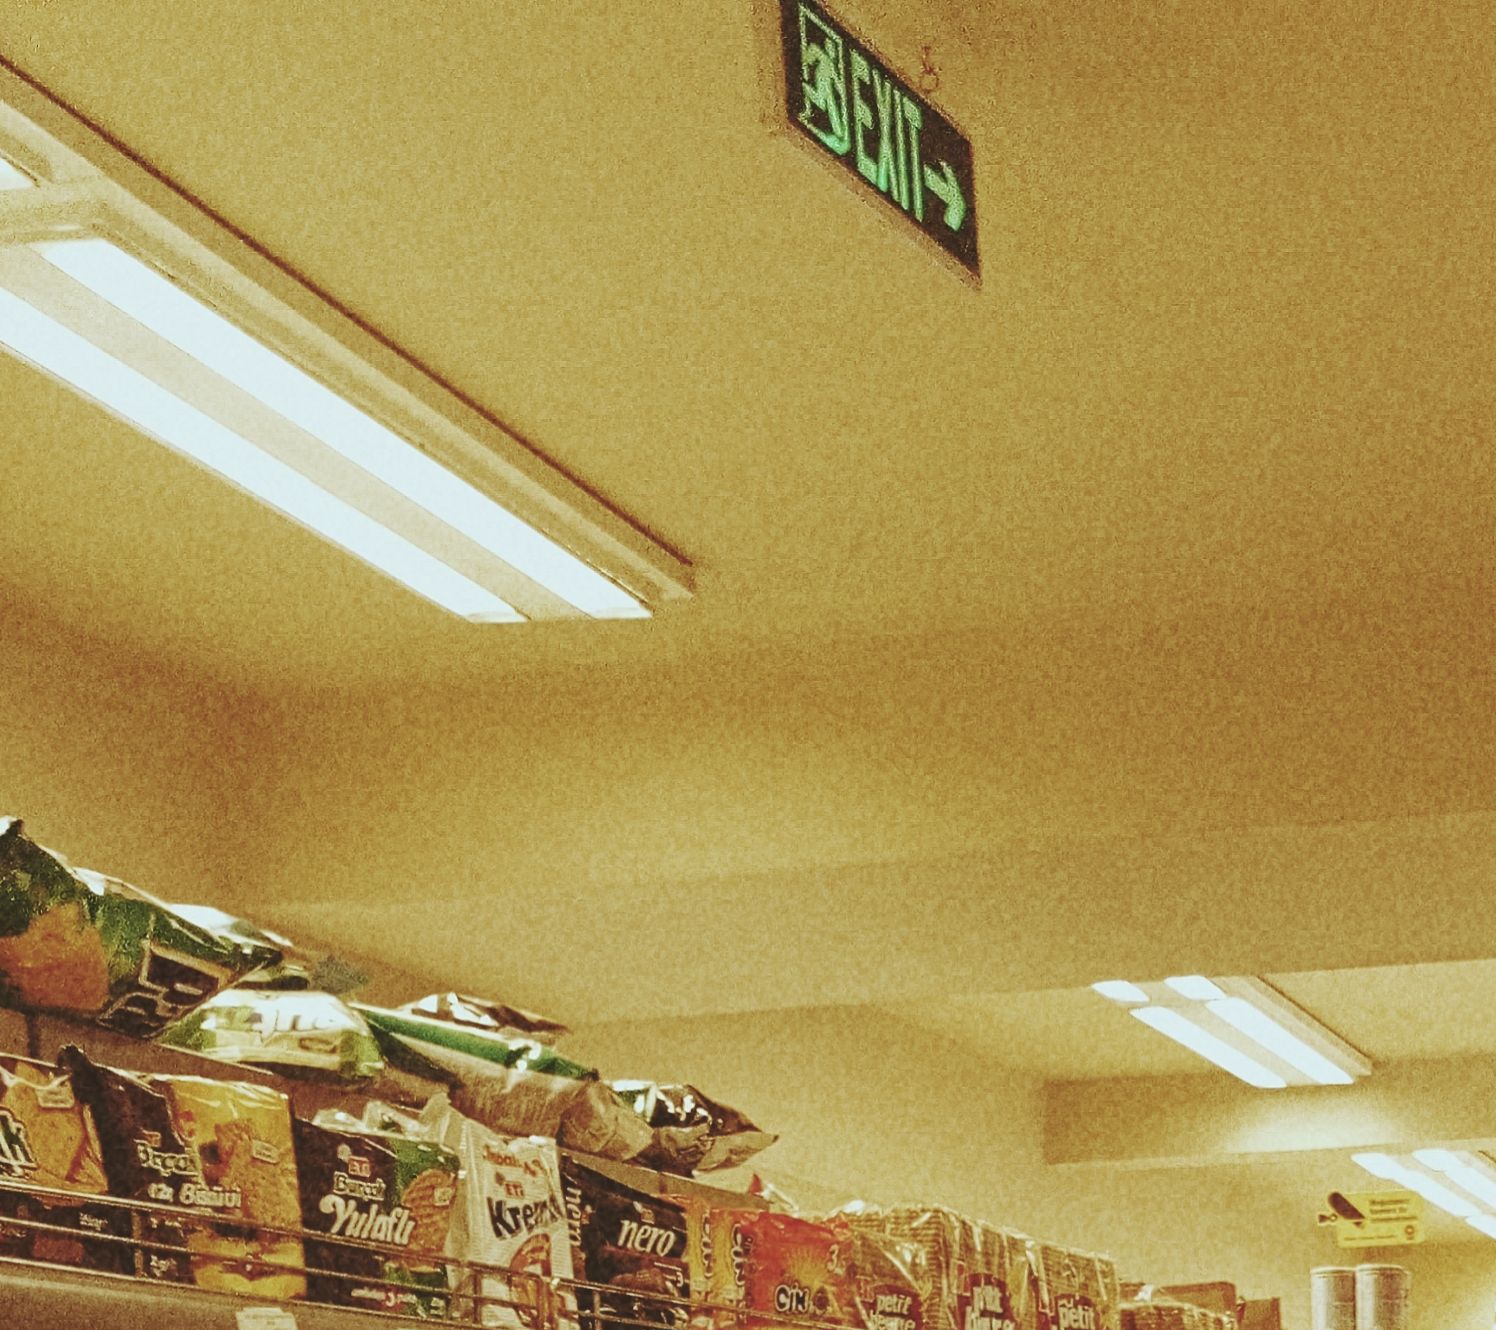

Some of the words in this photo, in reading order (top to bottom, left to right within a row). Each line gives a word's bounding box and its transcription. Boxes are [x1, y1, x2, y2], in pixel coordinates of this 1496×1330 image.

[850, 49, 922, 222] EXIT
[617, 1217, 676, 1258] nero
[1057, 1303, 1096, 1330] petit
